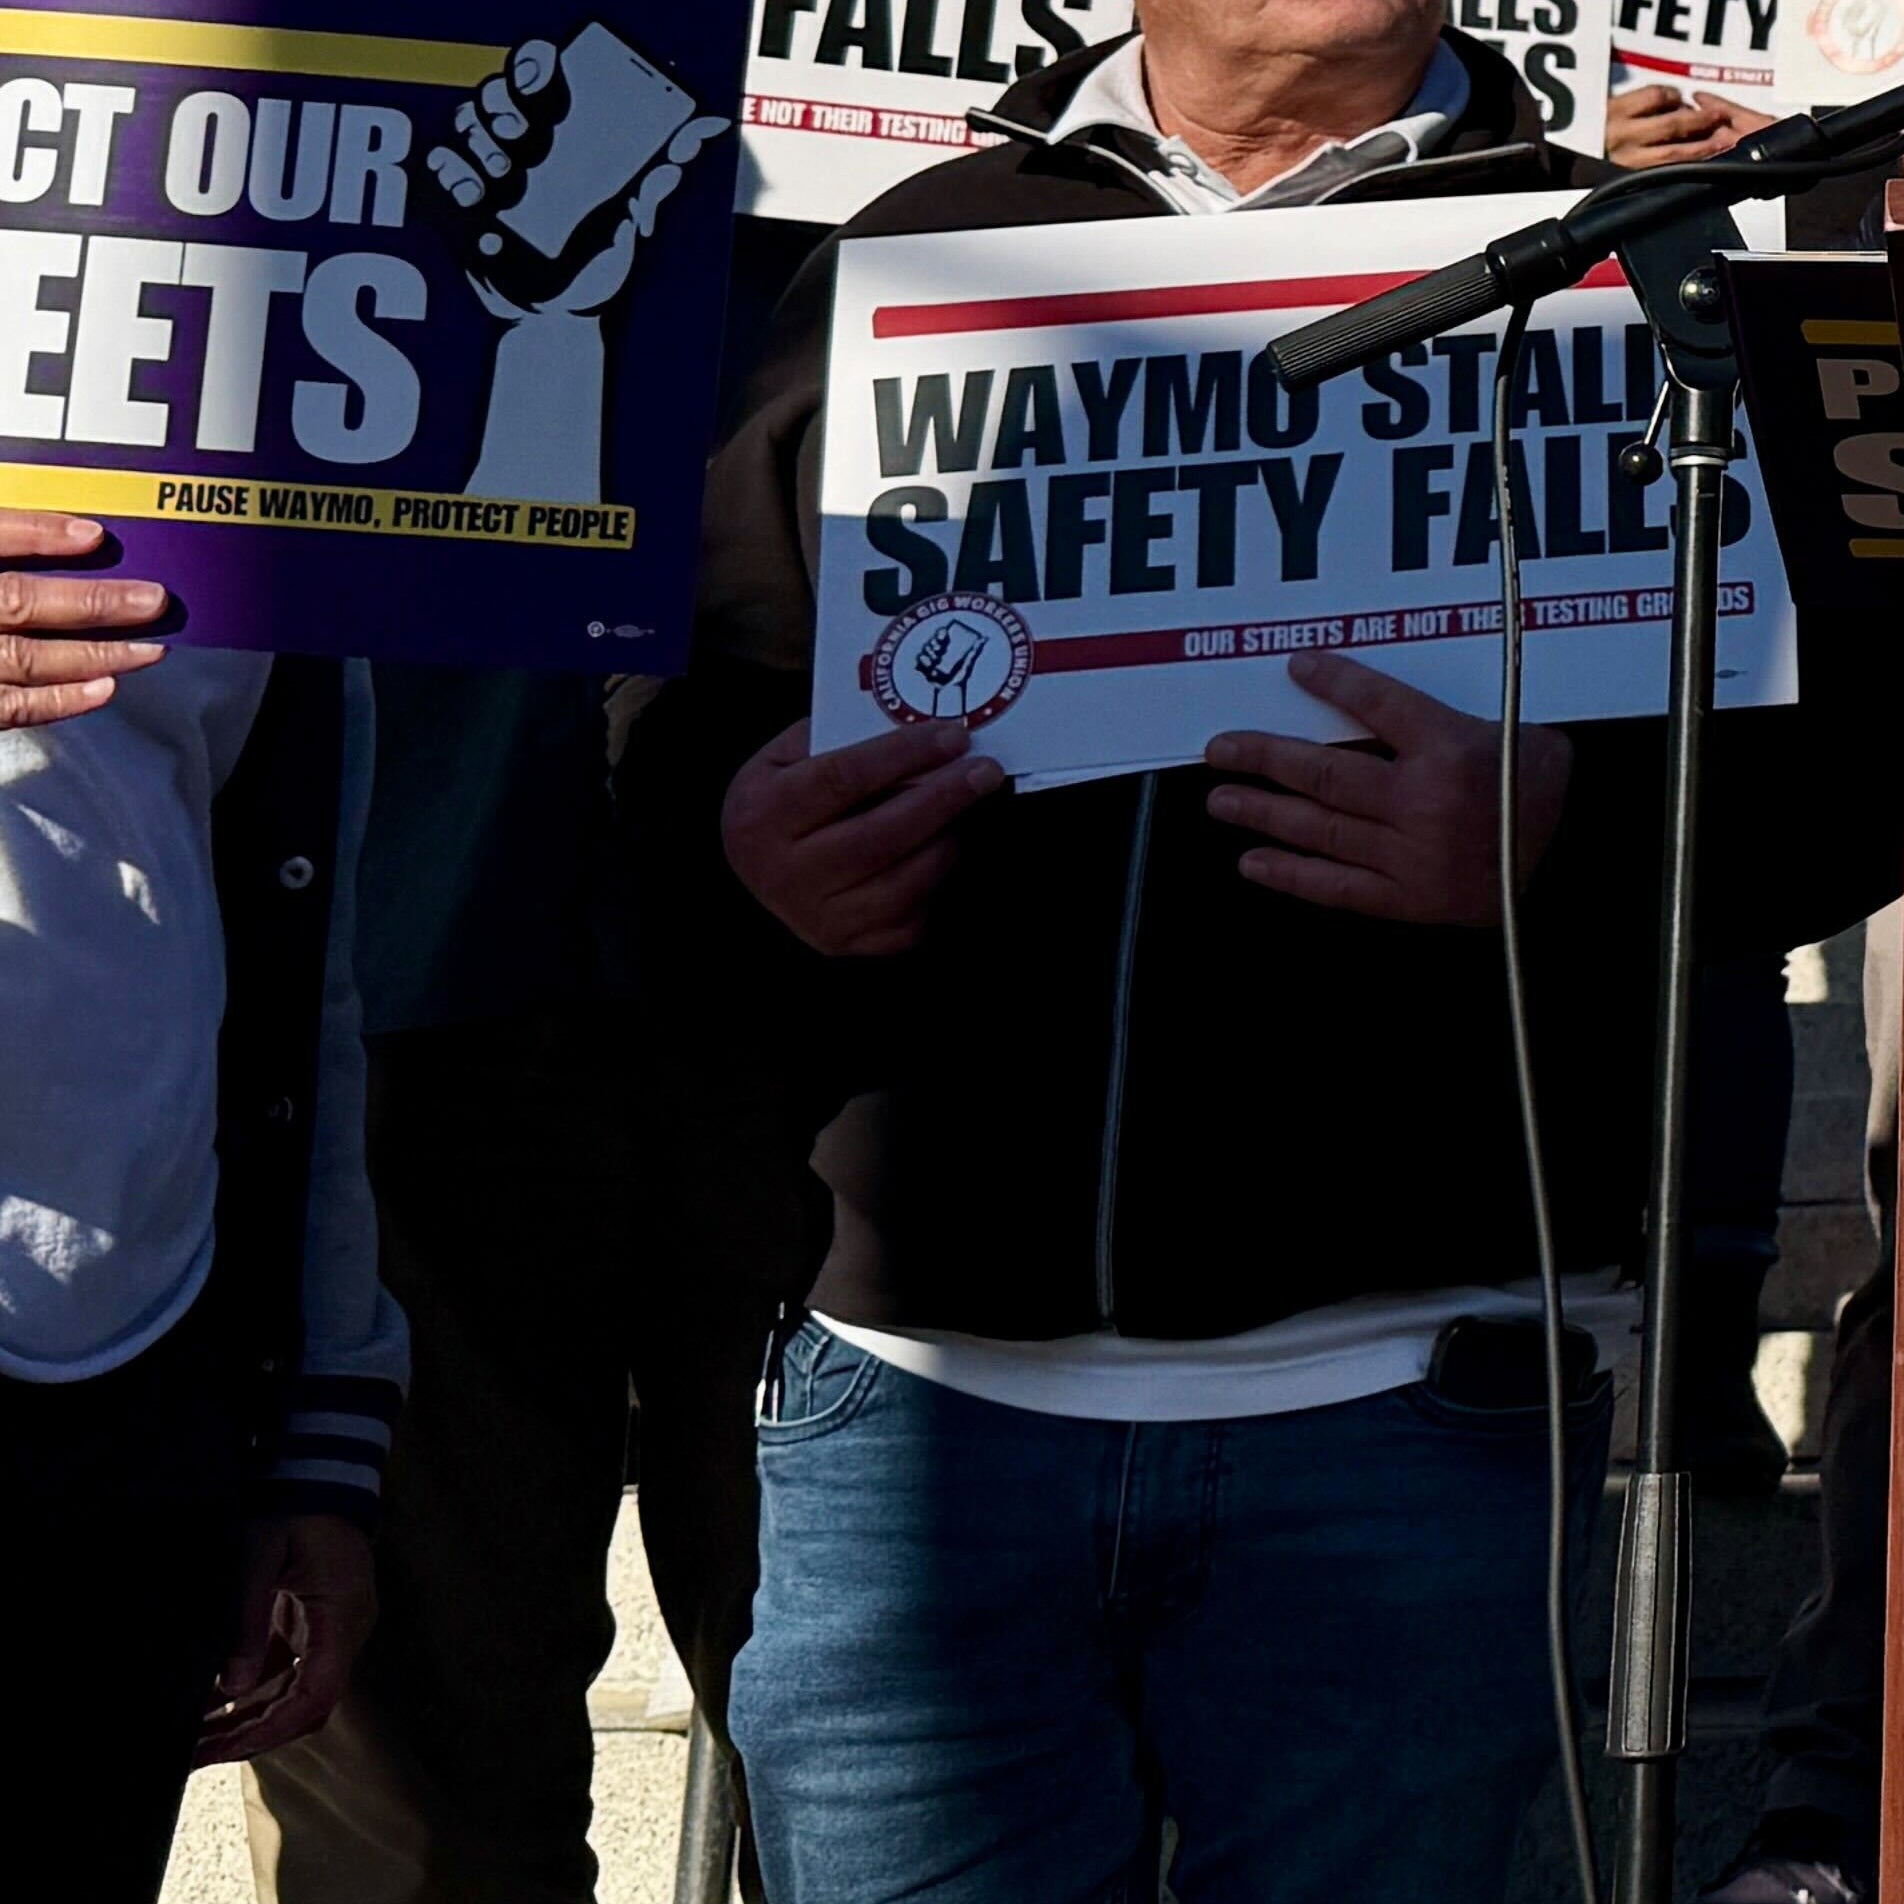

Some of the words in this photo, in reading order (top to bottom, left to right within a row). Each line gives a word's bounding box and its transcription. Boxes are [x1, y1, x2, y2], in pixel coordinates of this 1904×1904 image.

[164, 91, 413, 229] OUR
[760, 98, 806, 126] NOT
[812, 104, 873, 135] THEIR
[880, 113, 966, 144] TESTING
[0, 229, 427, 463] EETS
[873, 351, 1319, 477] WAYMO
[1362, 324, 1741, 441] STALL
[157, 481, 250, 516] PAUSE
[259, 488, 382, 529] WAYMO,
[392, 496, 520, 534] PROTECT
[527, 507, 629, 541] PEOPLE
[864, 452, 1344, 616] SAFETY
[1183, 627, 1235, 657] OUR
[1242, 618, 1344, 652] STREETS
[1351, 613, 1396, 643] ARE
[1404, 608, 1449, 637] NOT
[1535, 594, 1629, 626] TESTING
